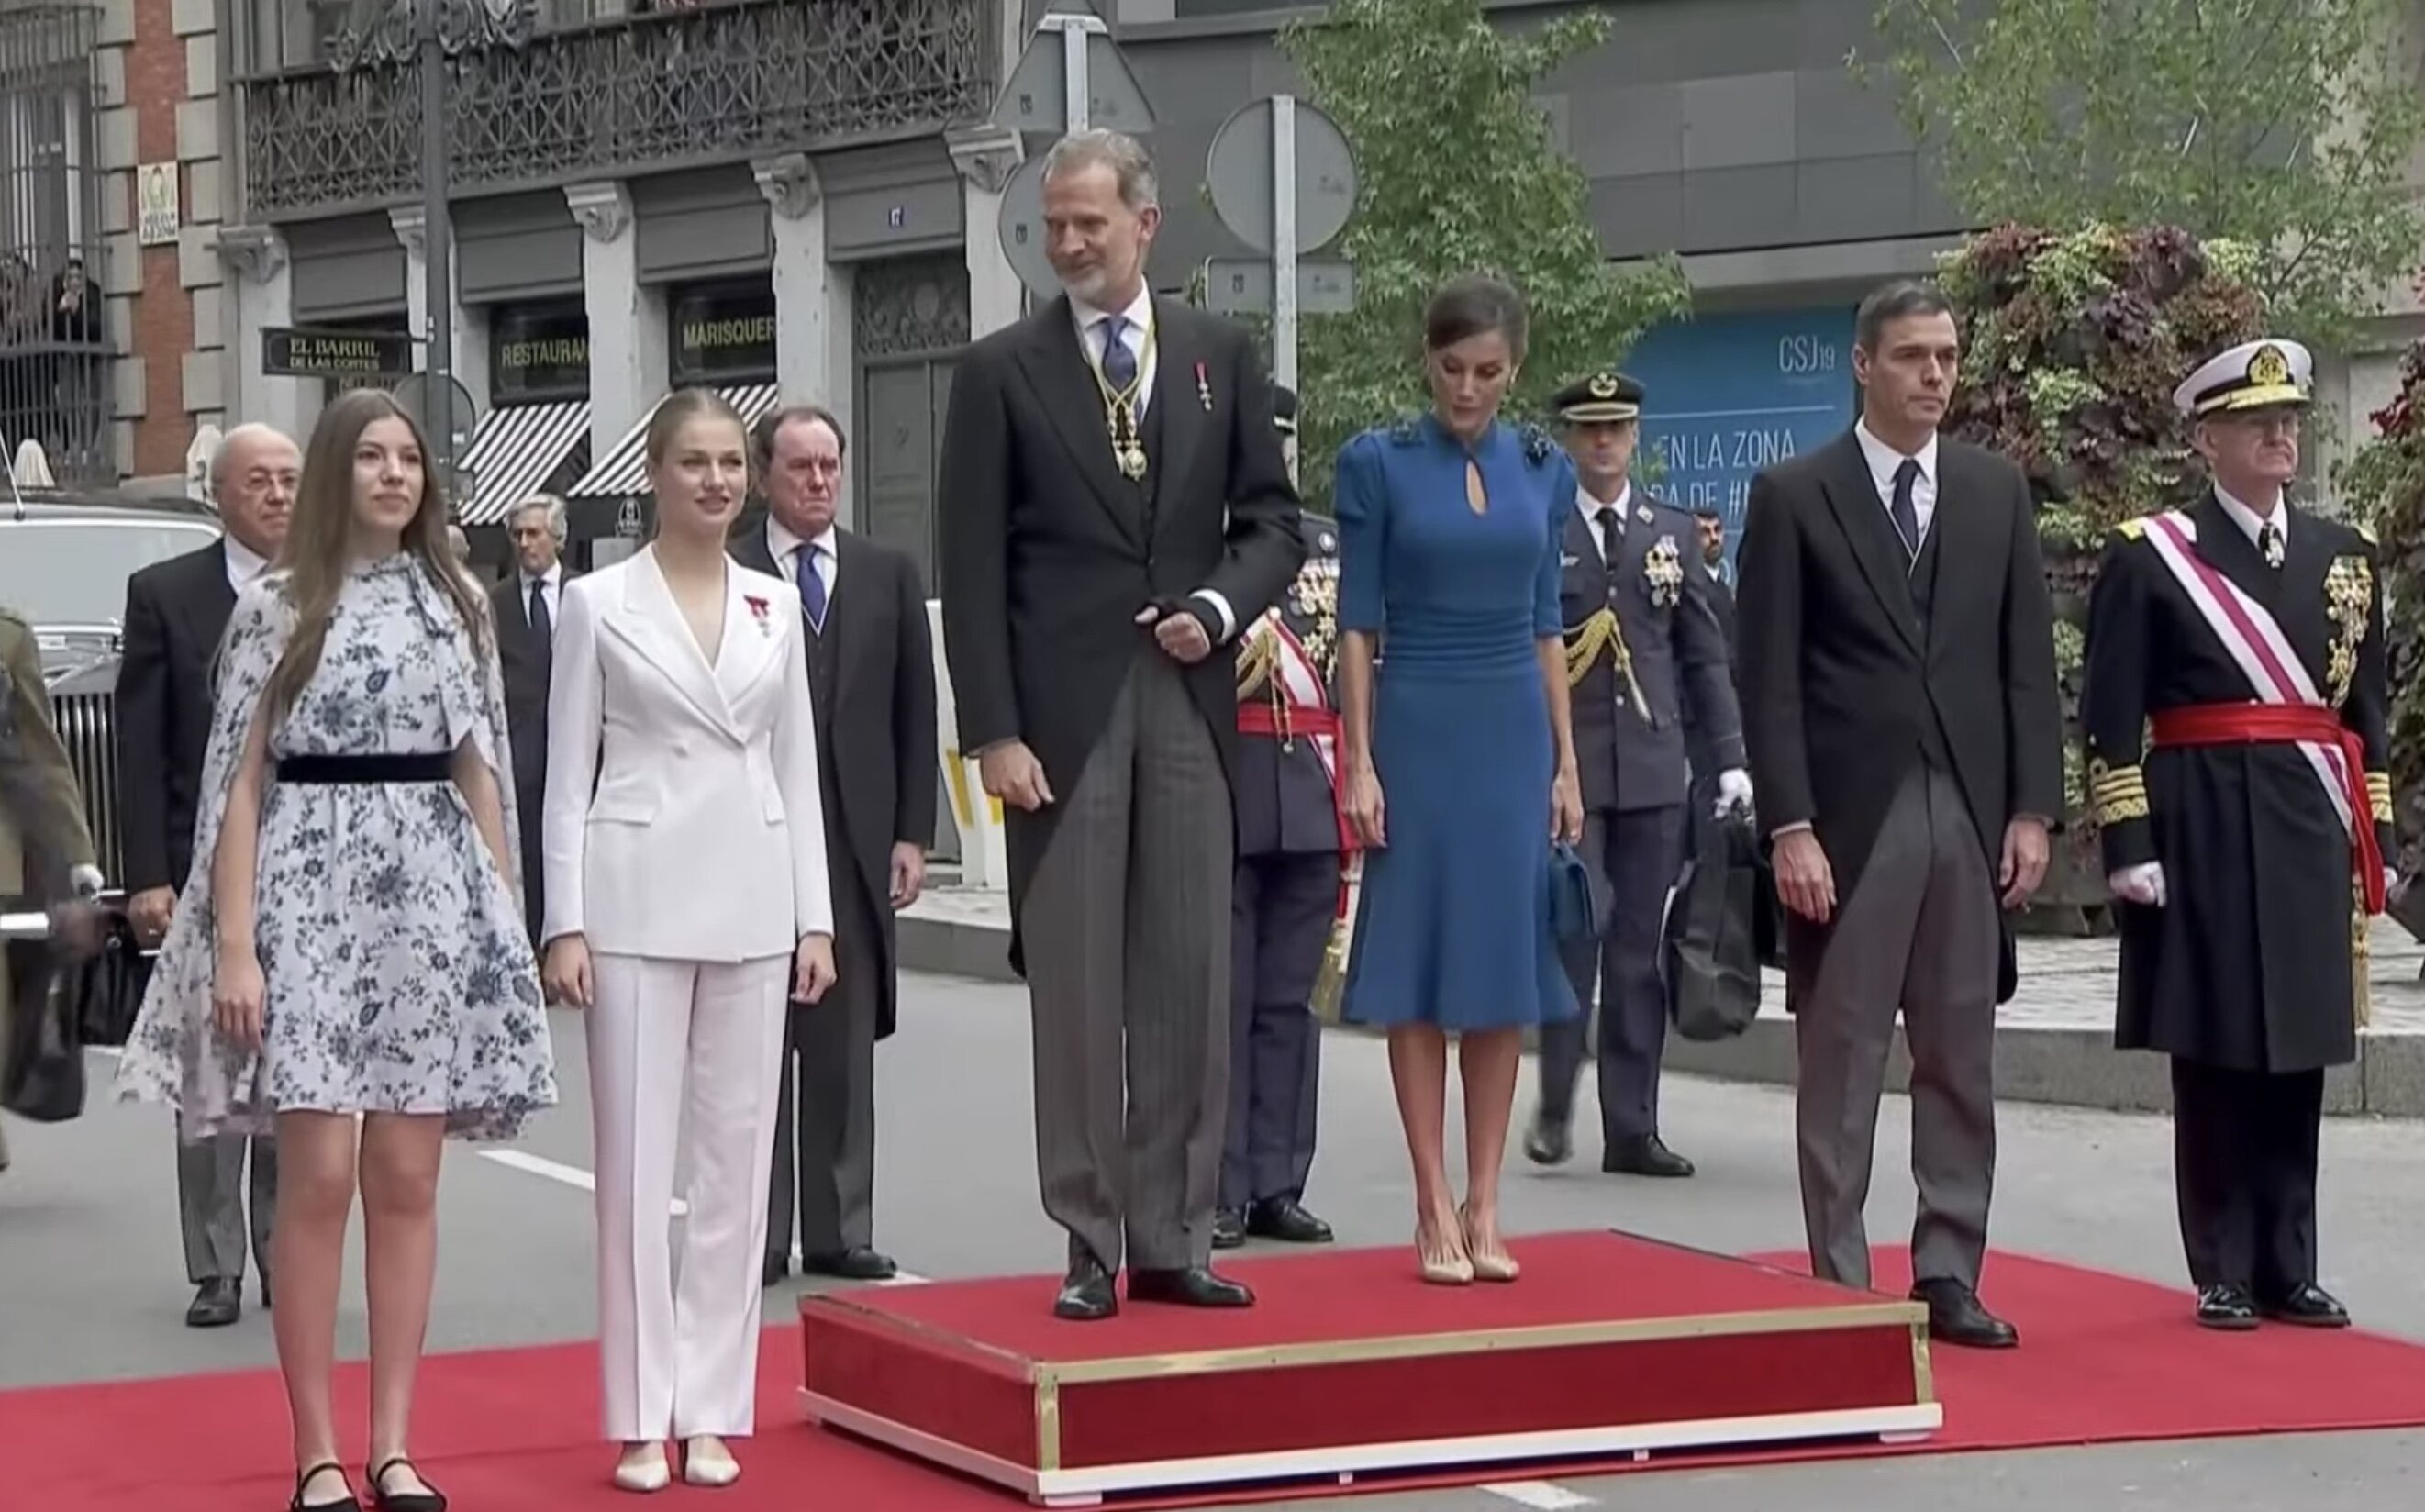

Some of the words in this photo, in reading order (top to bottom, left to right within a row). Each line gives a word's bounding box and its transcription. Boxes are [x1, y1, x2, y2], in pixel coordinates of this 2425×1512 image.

[290, 337, 312, 354] EL
[316, 339, 380, 357] BARRIL
[290, 356, 306, 368] DE
[308, 357, 331, 369] LAS
[333, 358, 380, 372] CORTES
[1693, 433, 1725, 470] LA
[1732, 428, 1796, 468] ZONA
